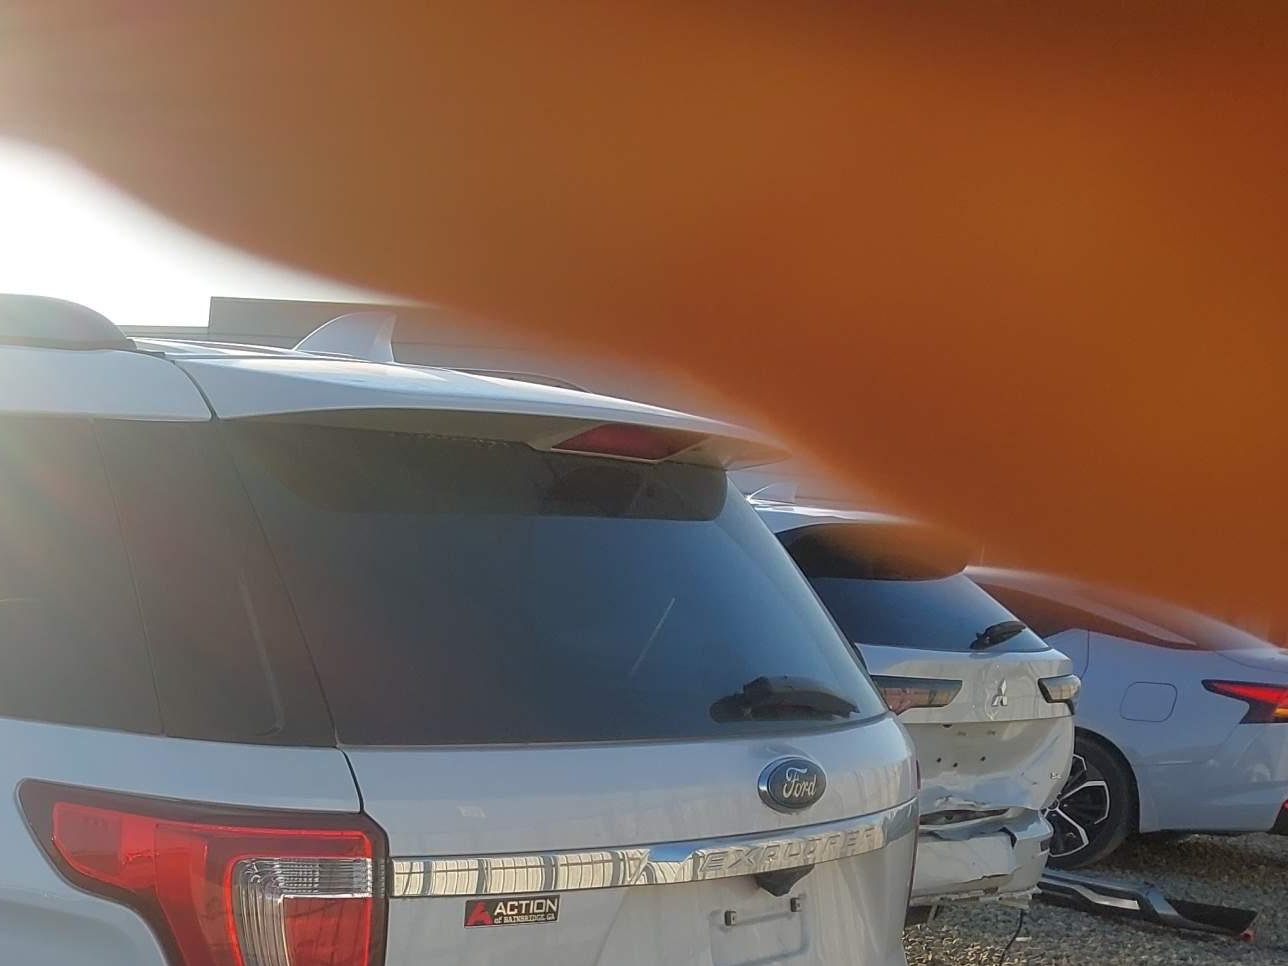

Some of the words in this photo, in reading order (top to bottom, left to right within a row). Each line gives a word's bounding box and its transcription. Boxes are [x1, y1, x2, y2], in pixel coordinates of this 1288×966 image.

[783, 767, 817, 799] Ford
[698, 826, 876, 873] EXPLORER
[494, 898, 558, 916] ACTION
